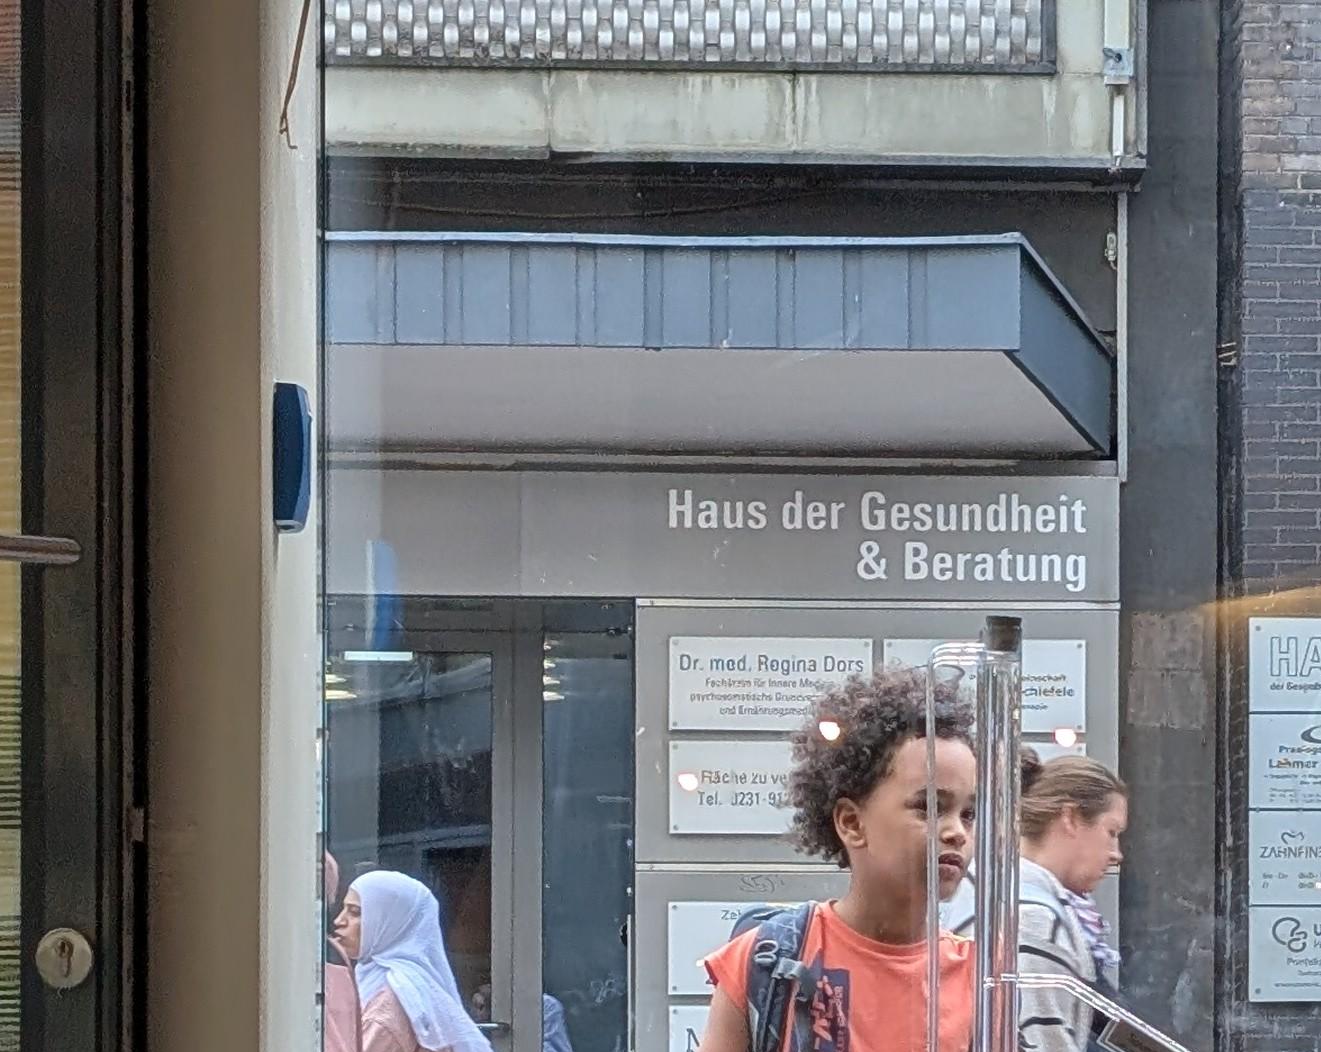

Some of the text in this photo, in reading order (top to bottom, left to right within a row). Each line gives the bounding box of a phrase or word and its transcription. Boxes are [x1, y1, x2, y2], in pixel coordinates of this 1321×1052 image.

[668, 489, 1088, 534] Haus der Gesundheit
[856, 540, 1088, 593] & Beratung
[679, 653, 704, 672] Dr.
[709, 654, 751, 672] med.
[757, 654, 817, 676] Regina
[750, 772, 767, 785] zu
[698, 790, 723, 806] Tel.
